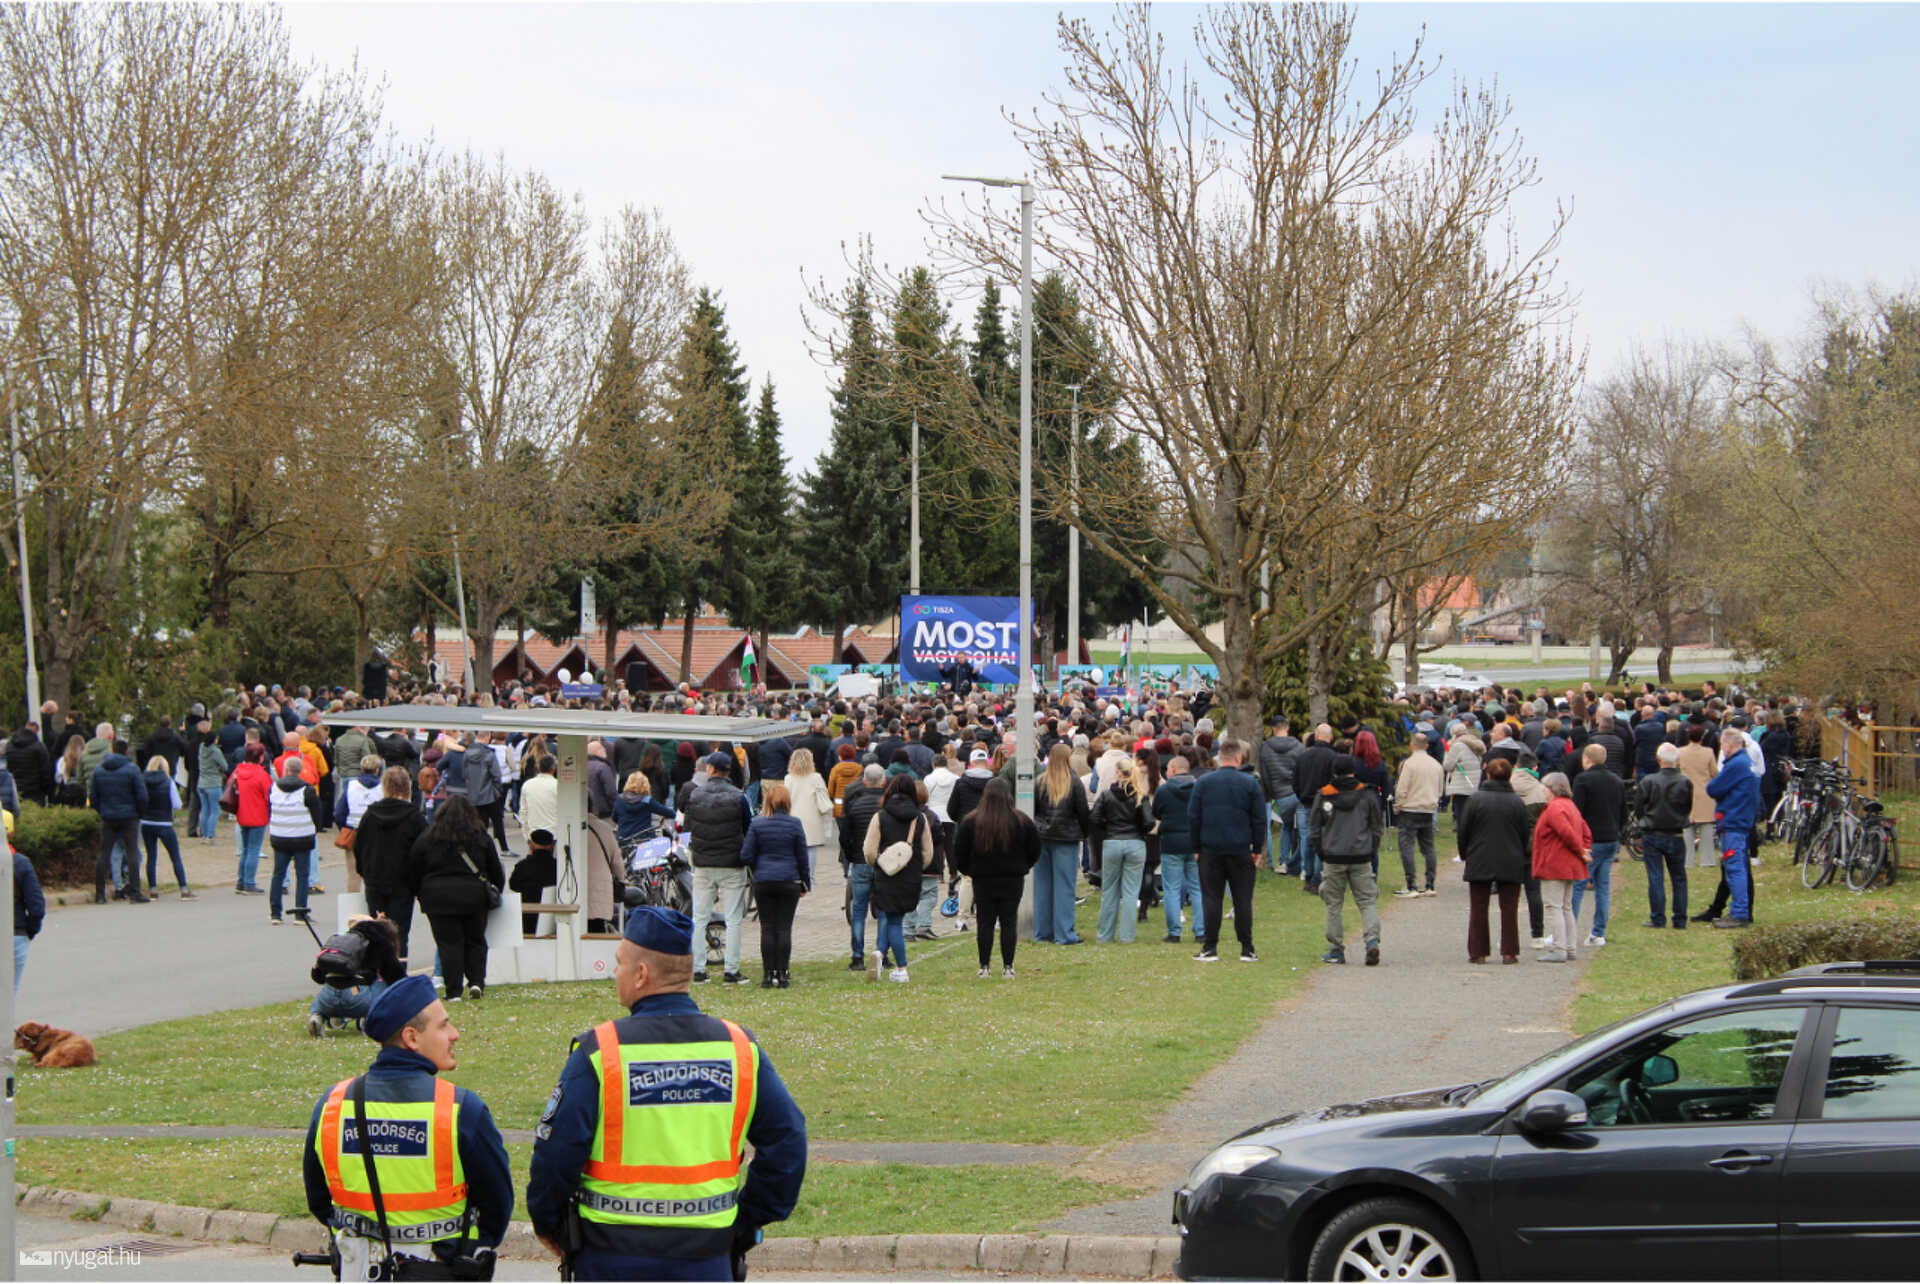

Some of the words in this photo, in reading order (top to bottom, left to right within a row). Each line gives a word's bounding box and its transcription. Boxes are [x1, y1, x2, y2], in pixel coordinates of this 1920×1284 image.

[933, 606, 954, 614] TISZA
[913, 621, 1017, 649] MOST
[913, 650, 957, 663] VAGY
[662, 1088, 701, 1100] POLICE
[601, 1197, 666, 1214] POLICE
[672, 1195, 728, 1214] POLICE
